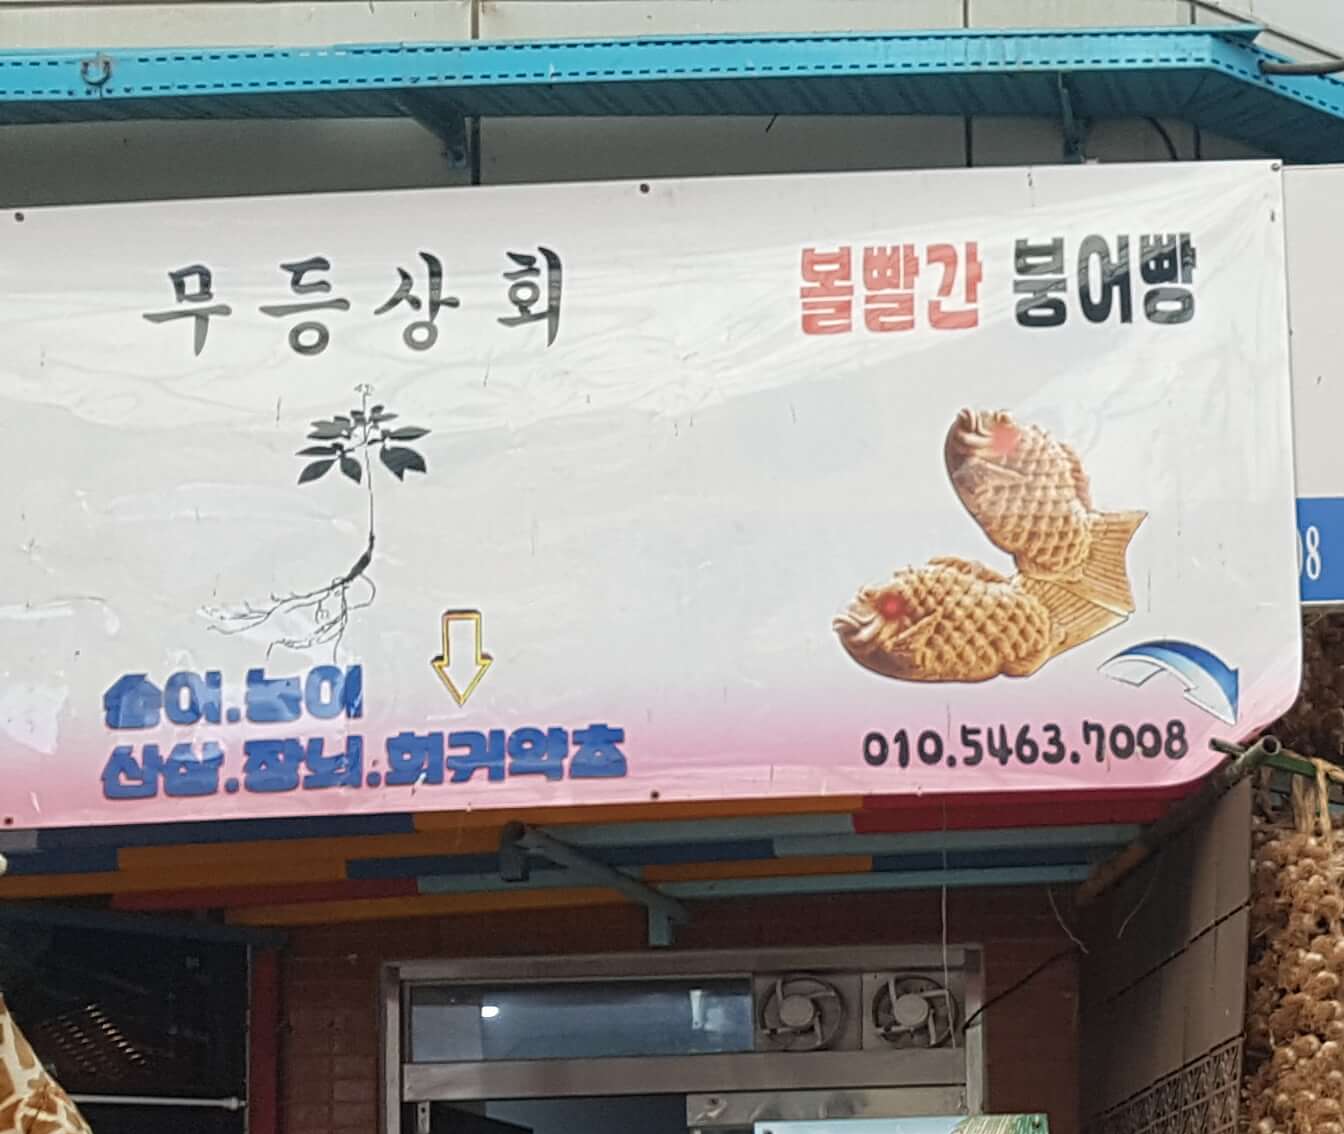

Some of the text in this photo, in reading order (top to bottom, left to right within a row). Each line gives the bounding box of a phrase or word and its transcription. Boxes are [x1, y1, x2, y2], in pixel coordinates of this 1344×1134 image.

[143, 246, 564, 356] 무등상회
[800, 232, 1196, 335] 볼빨간 붕어빵
[862, 719, 1189, 769] 010.5463.7008
